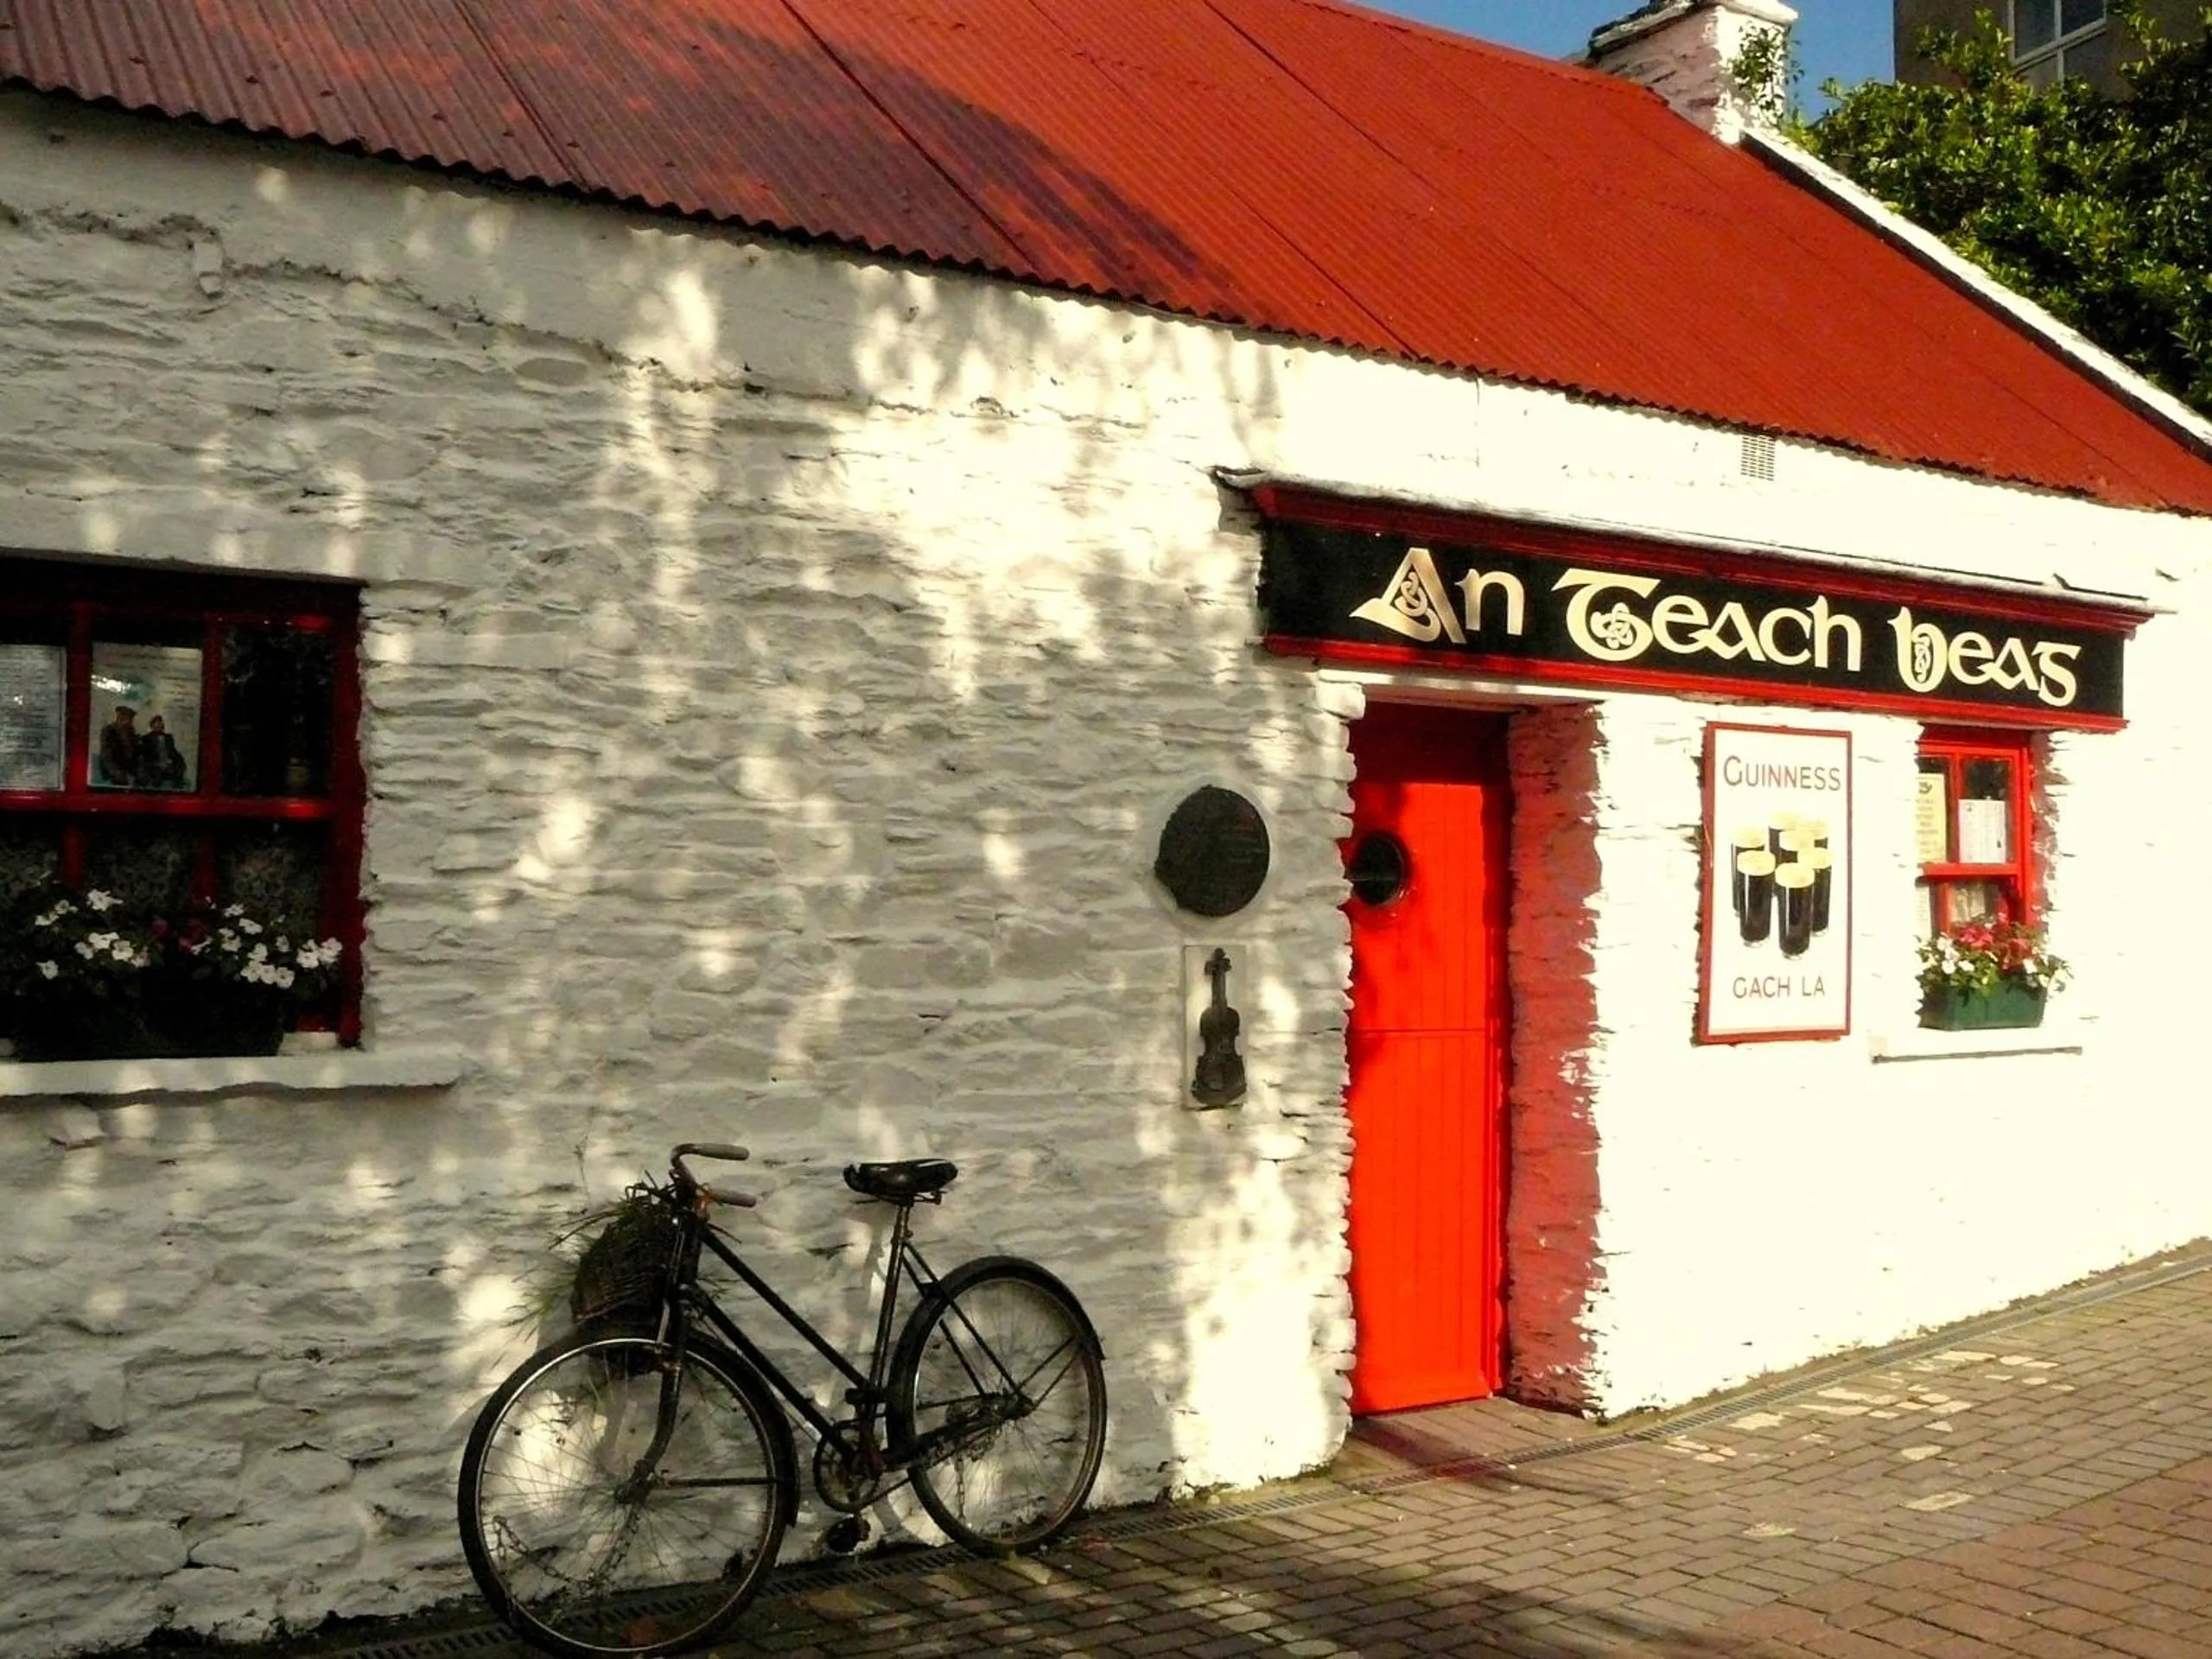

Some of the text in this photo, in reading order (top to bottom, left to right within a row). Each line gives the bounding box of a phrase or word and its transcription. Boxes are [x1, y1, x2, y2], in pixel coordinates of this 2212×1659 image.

[1349, 547, 1525, 644] An
[1723, 755, 1841, 791] GUINNESS
[1732, 976, 1790, 999] GACH
